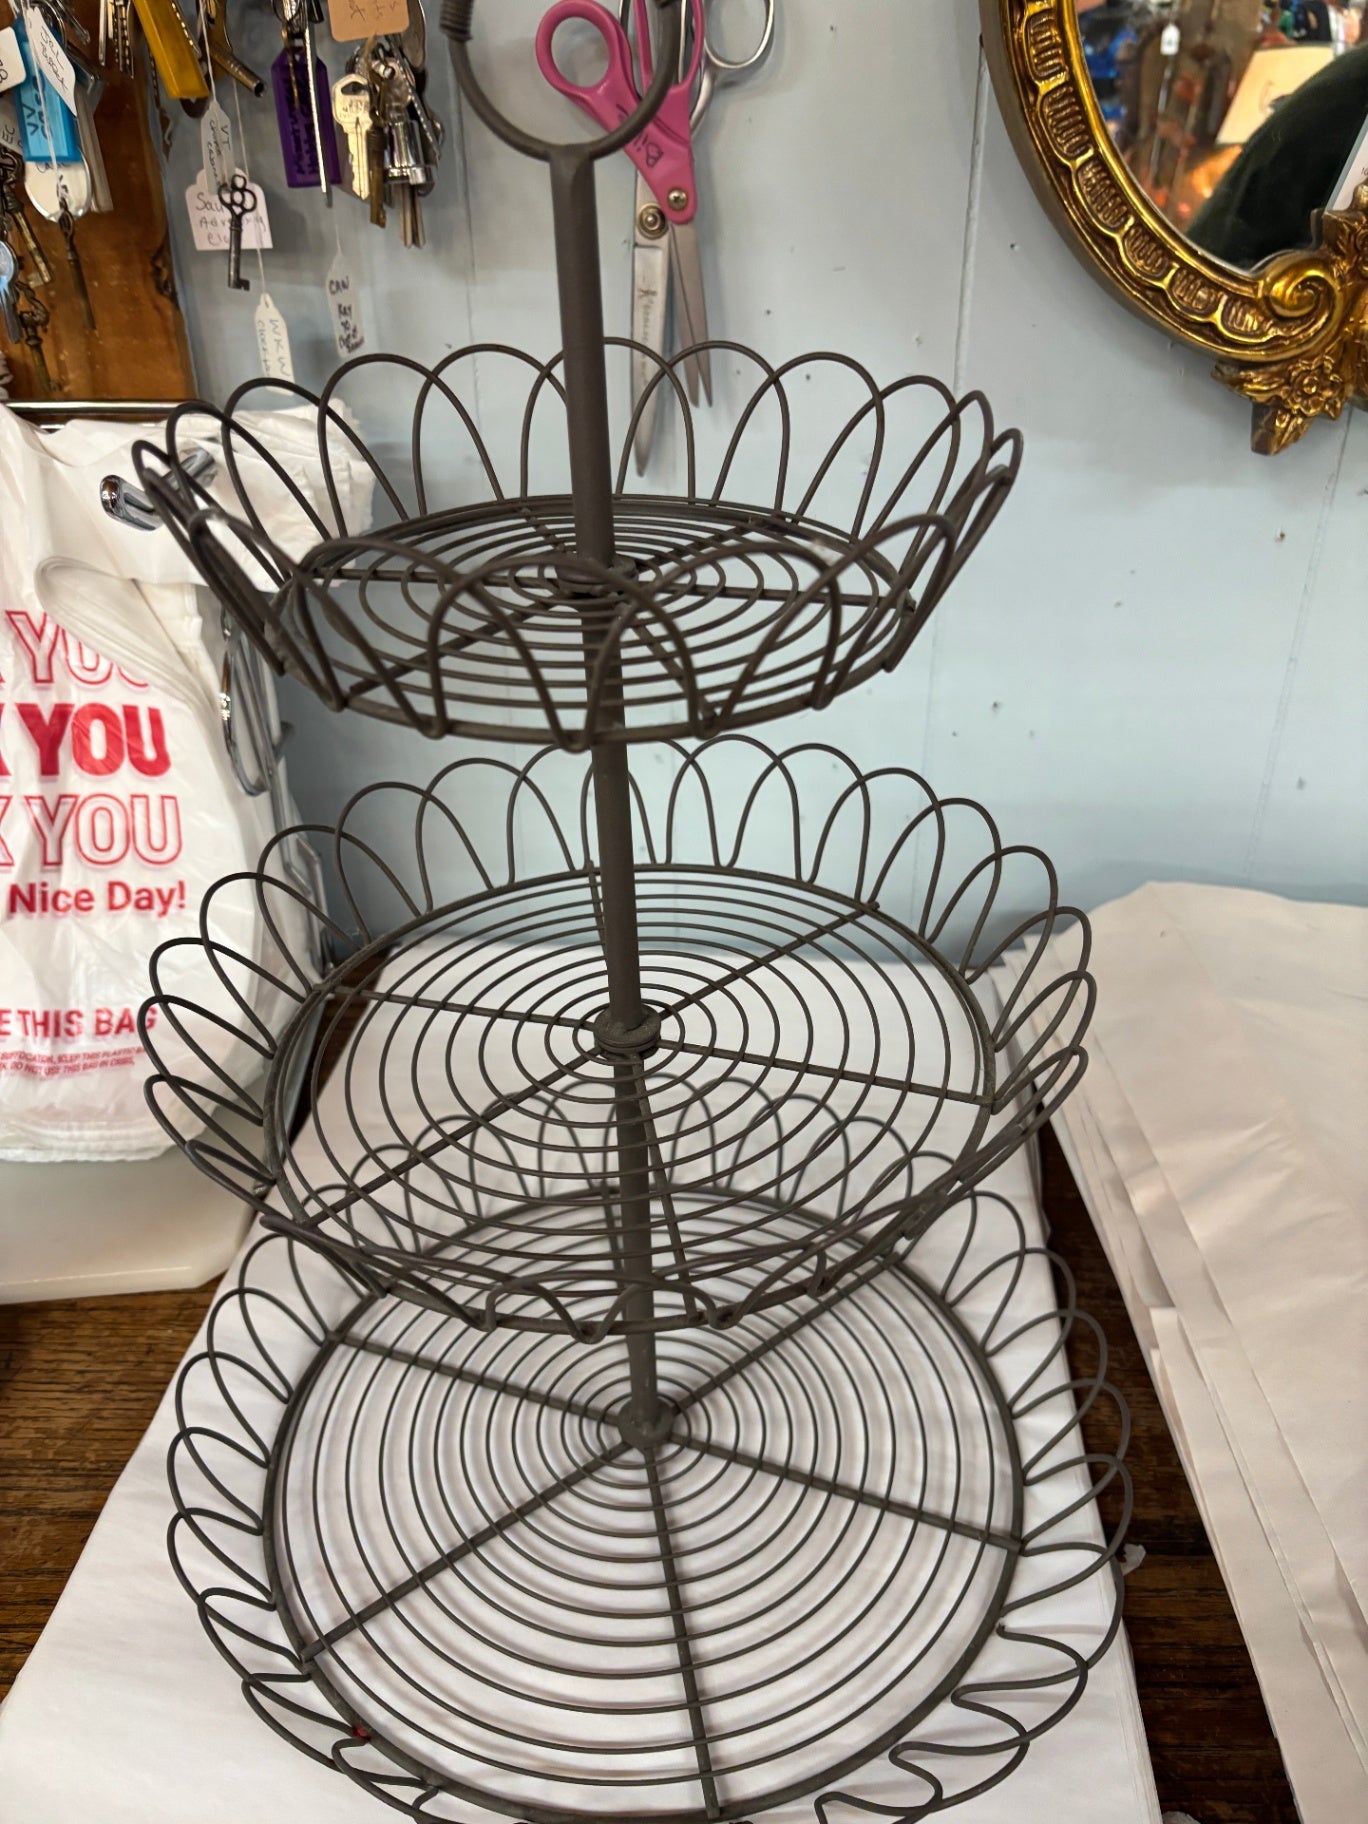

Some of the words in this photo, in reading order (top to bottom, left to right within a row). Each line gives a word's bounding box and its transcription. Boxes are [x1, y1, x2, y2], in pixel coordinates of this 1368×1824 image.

[15, 702, 172, 777] YOU
[24, 793, 183, 867] YOU
[9, 881, 95, 913] Nice
[107, 880, 186, 918] Day!
[17, 1008, 84, 1038] THIS
[94, 1007, 158, 1036] BAG
